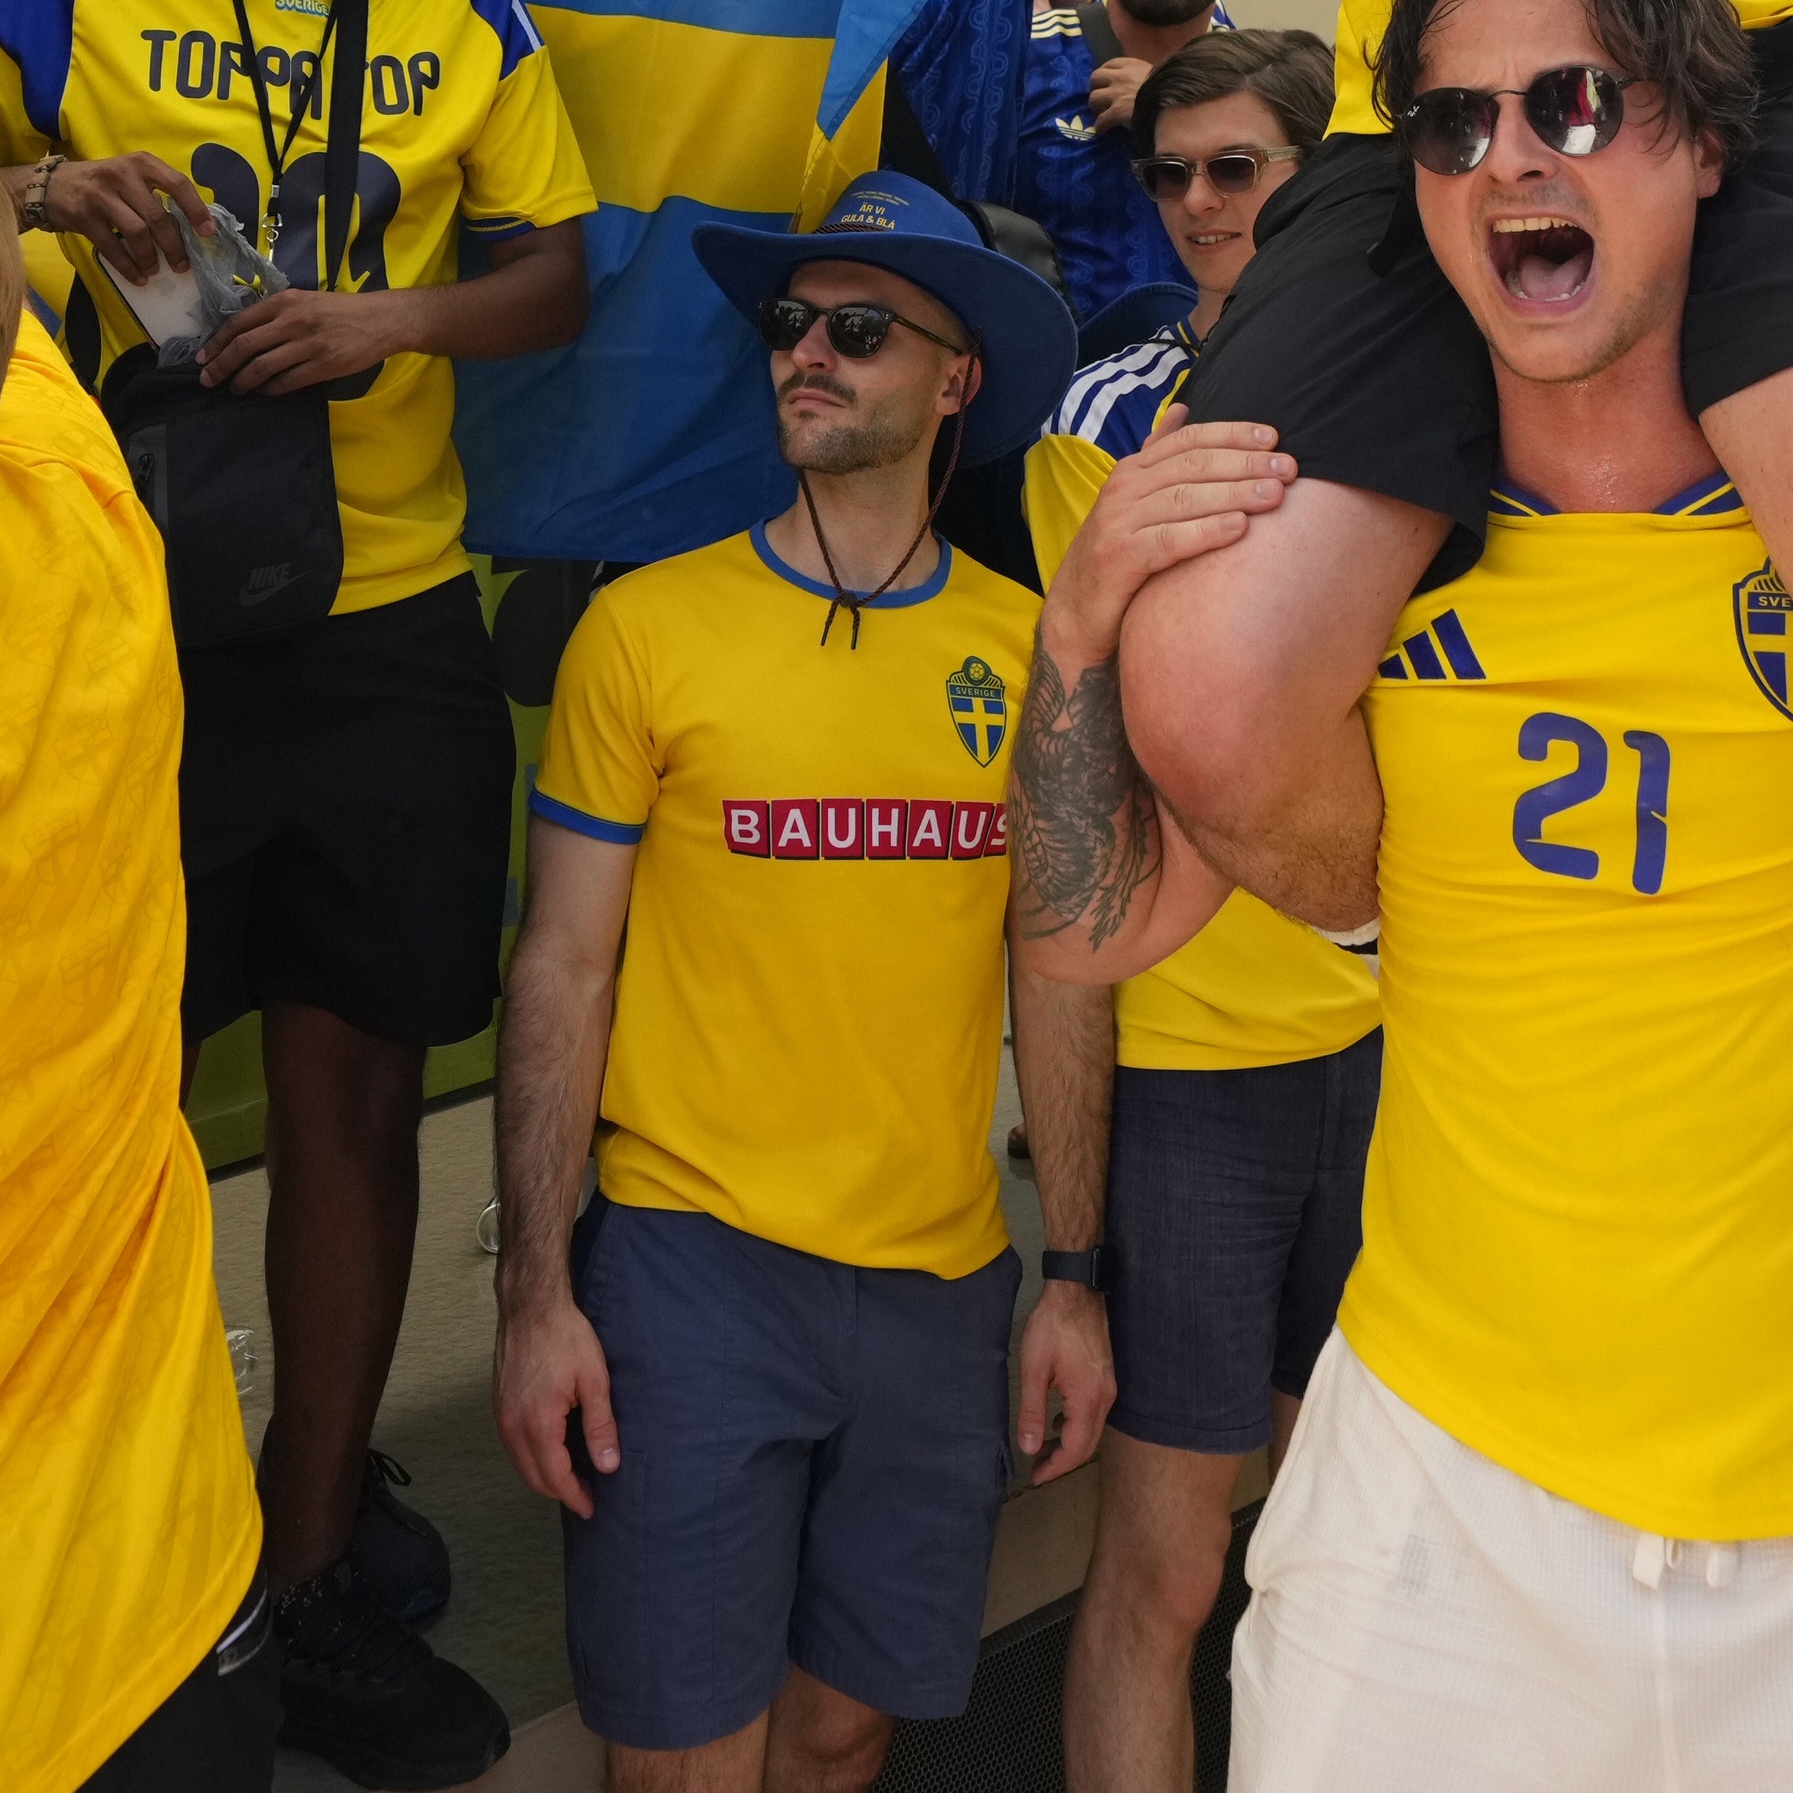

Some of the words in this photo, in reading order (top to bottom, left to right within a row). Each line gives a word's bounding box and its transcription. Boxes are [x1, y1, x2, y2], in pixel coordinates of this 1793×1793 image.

[859, 202, 874, 213] ÄR
[875, 206, 886, 215] VI
[841, 214, 864, 223] GULA
[866, 216, 874, 224] &
[876, 217, 896, 230] BLÅ
[247, 563, 292, 590] NIKE
[955, 687, 996, 697] SVERIGE
[1511, 711, 1671, 895] 21
